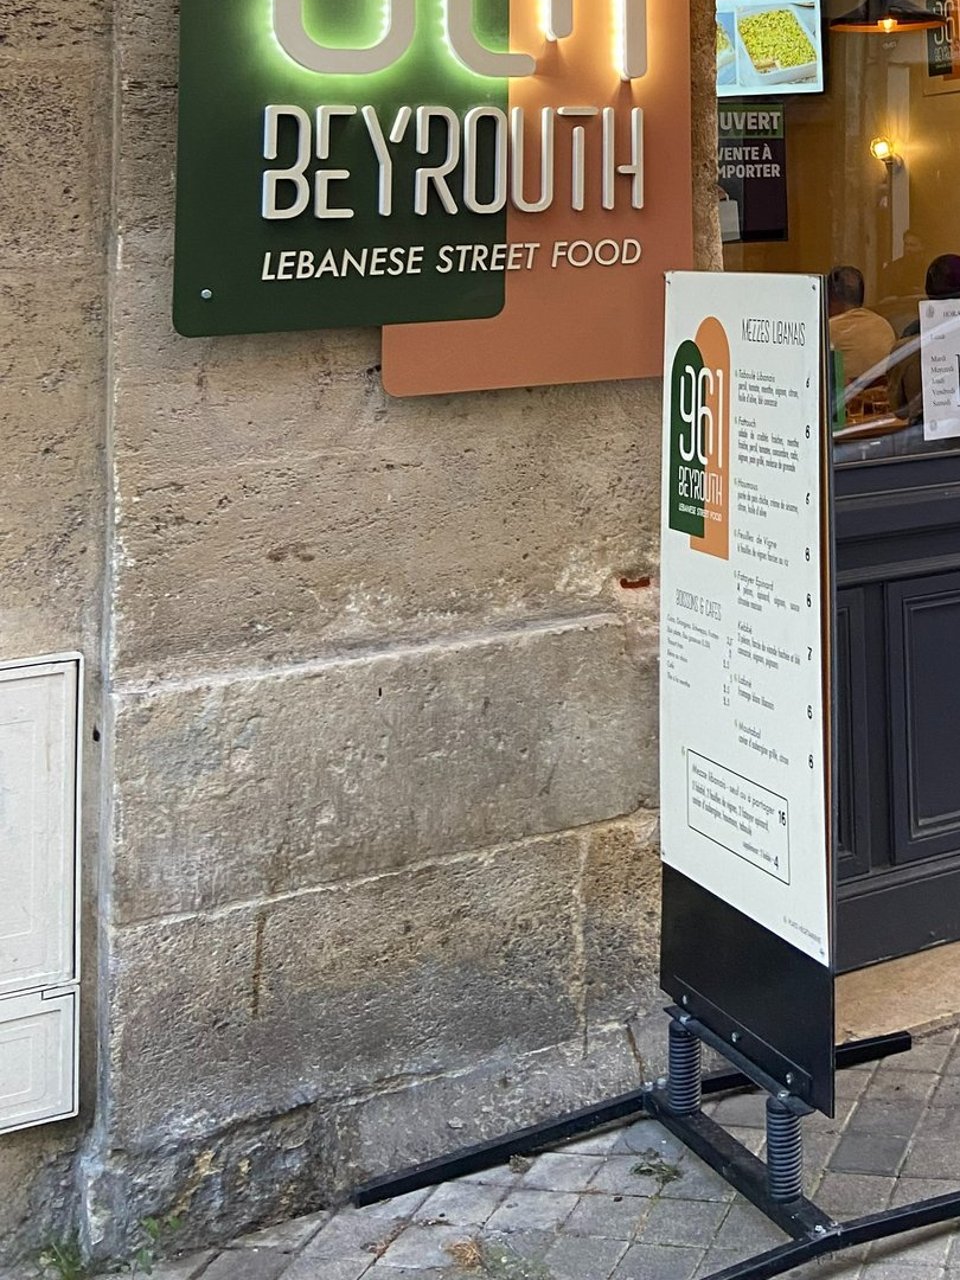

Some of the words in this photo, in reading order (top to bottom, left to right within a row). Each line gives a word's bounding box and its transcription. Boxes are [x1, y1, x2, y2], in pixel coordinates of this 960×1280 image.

[719, 111, 781, 130] UVERT
[762, 143, 772, 160] À
[261, 104, 644, 220] BEYROUTH
[717, 164, 781, 178] MPORTER
[262, 246, 424, 281] LEBANESE
[435, 242, 540, 274] STREET
[551, 238, 642, 269] FOOD
[742, 318, 770, 343] MEZZES
[772, 320, 806, 346] LIBANAIS
[679, 364, 723, 469] 961
[805, 425, 810, 439] 6
[678, 465, 723, 507] BEYROUTH
[806, 593, 811, 608] 6
[807, 646, 813, 661] 7
[807, 705, 812, 719] 6
